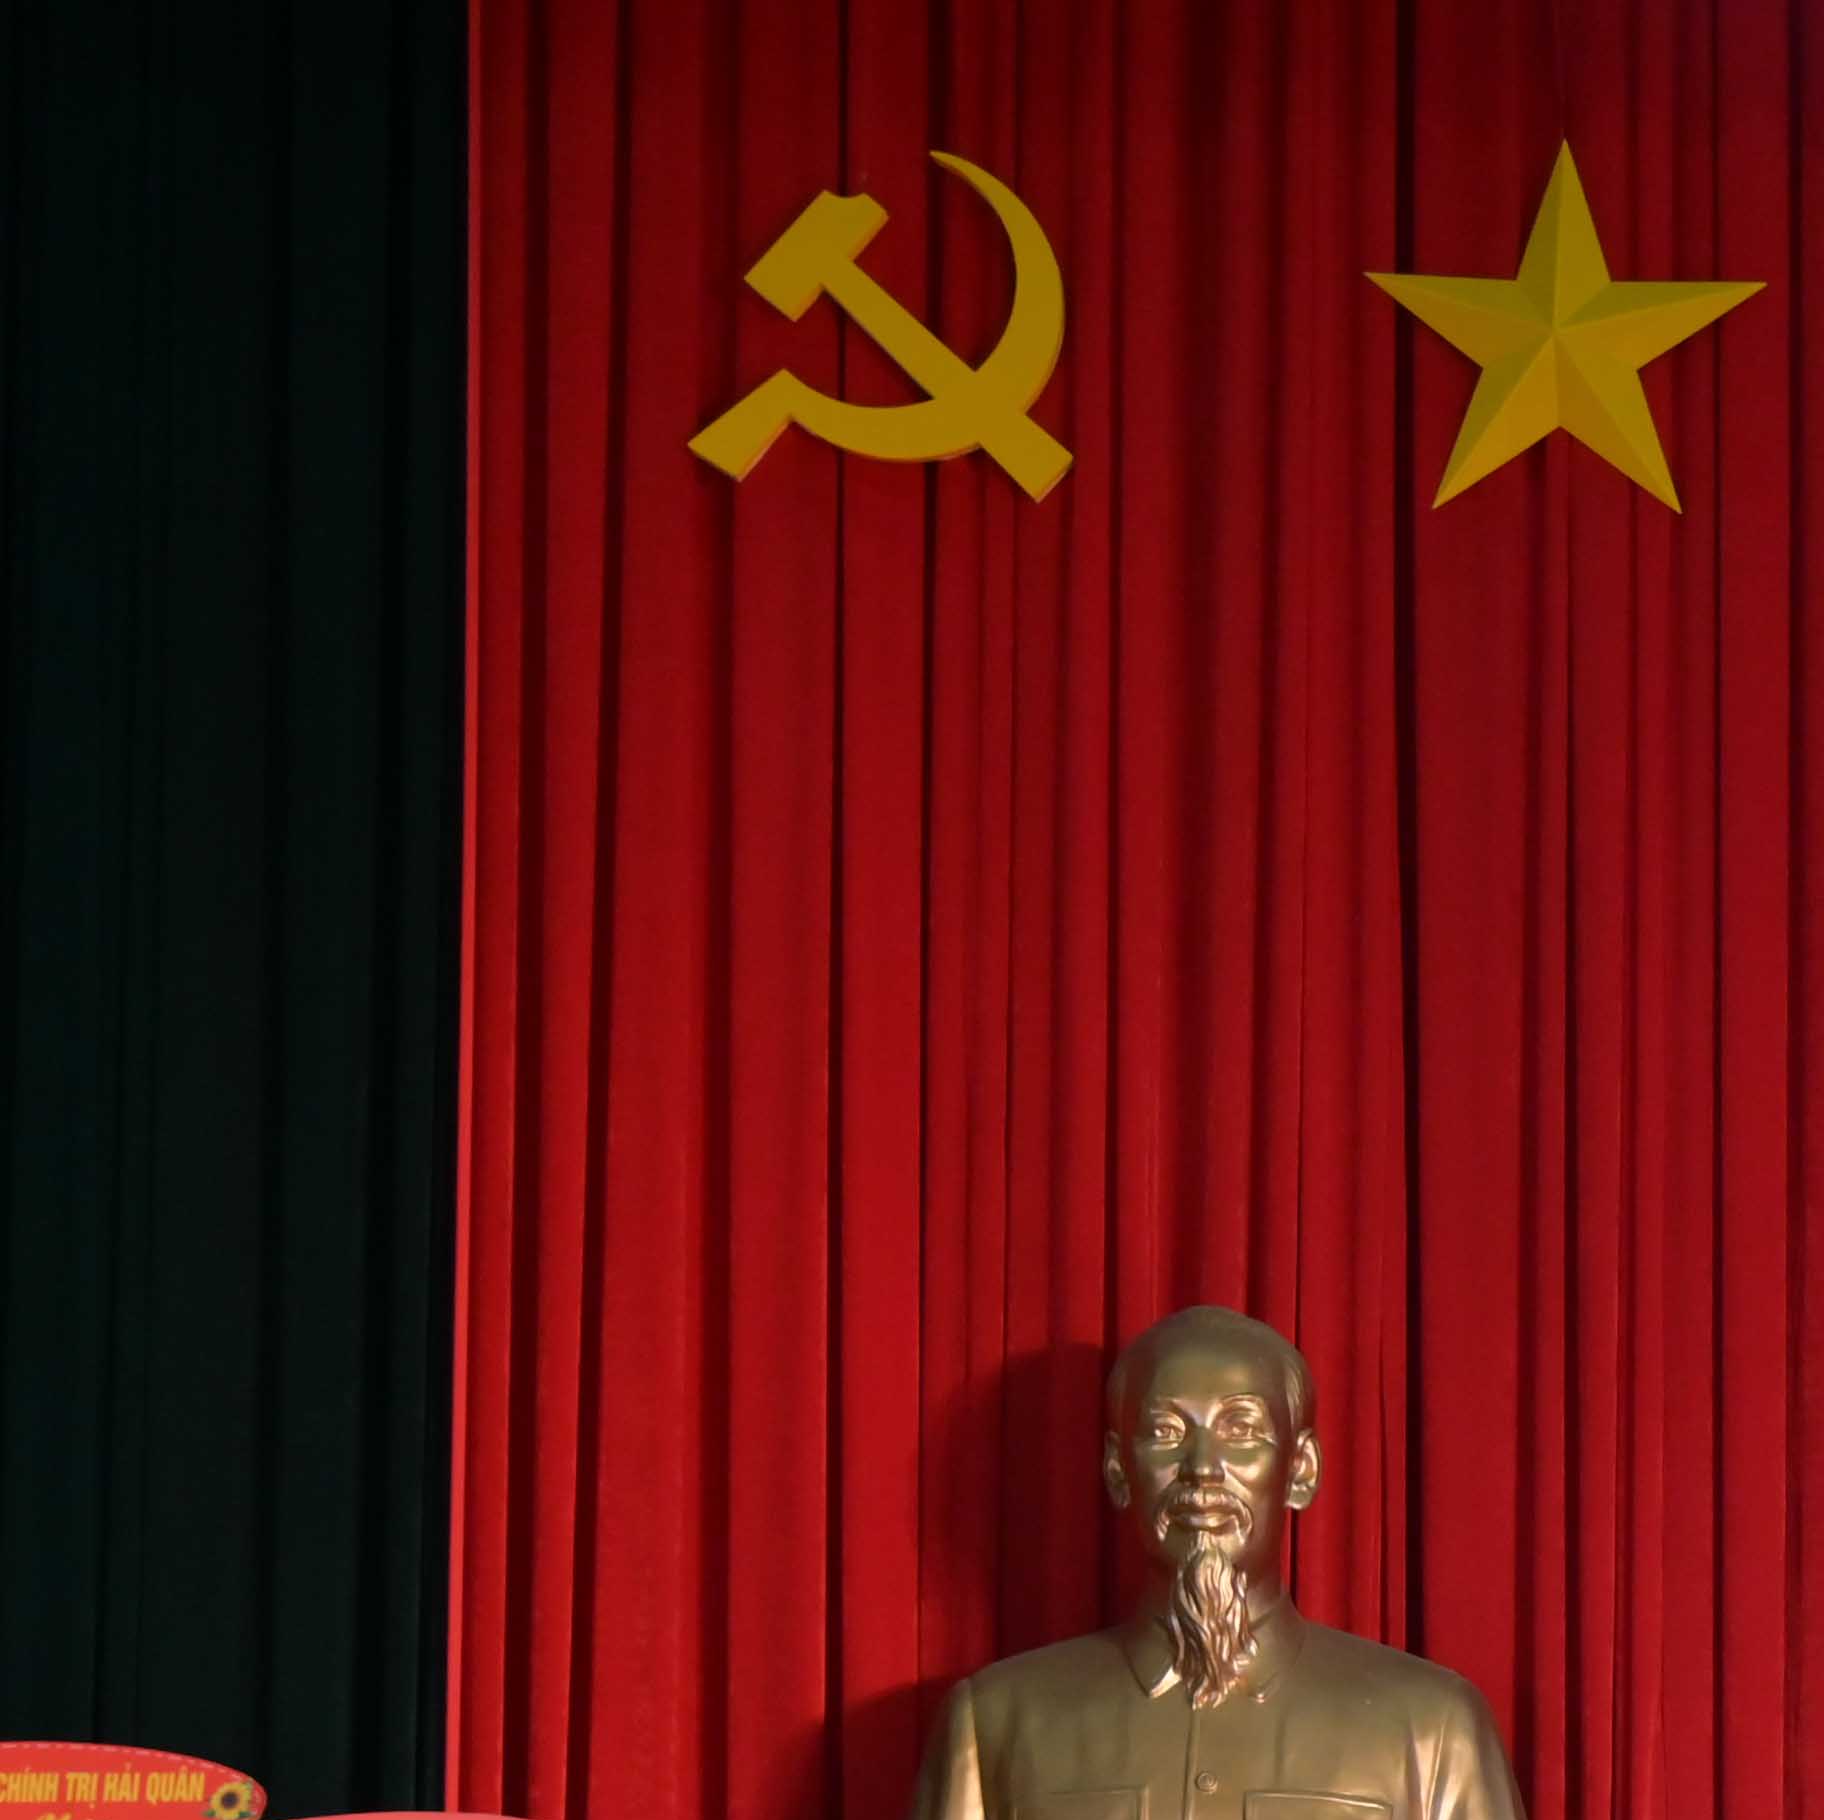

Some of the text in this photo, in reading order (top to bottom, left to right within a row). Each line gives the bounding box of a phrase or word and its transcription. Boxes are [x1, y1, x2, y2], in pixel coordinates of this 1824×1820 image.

[66, 1771, 98, 1810] TRỊ
[103, 1762, 141, 1803] HẢI
[146, 1765, 206, 1806] QUÂN
